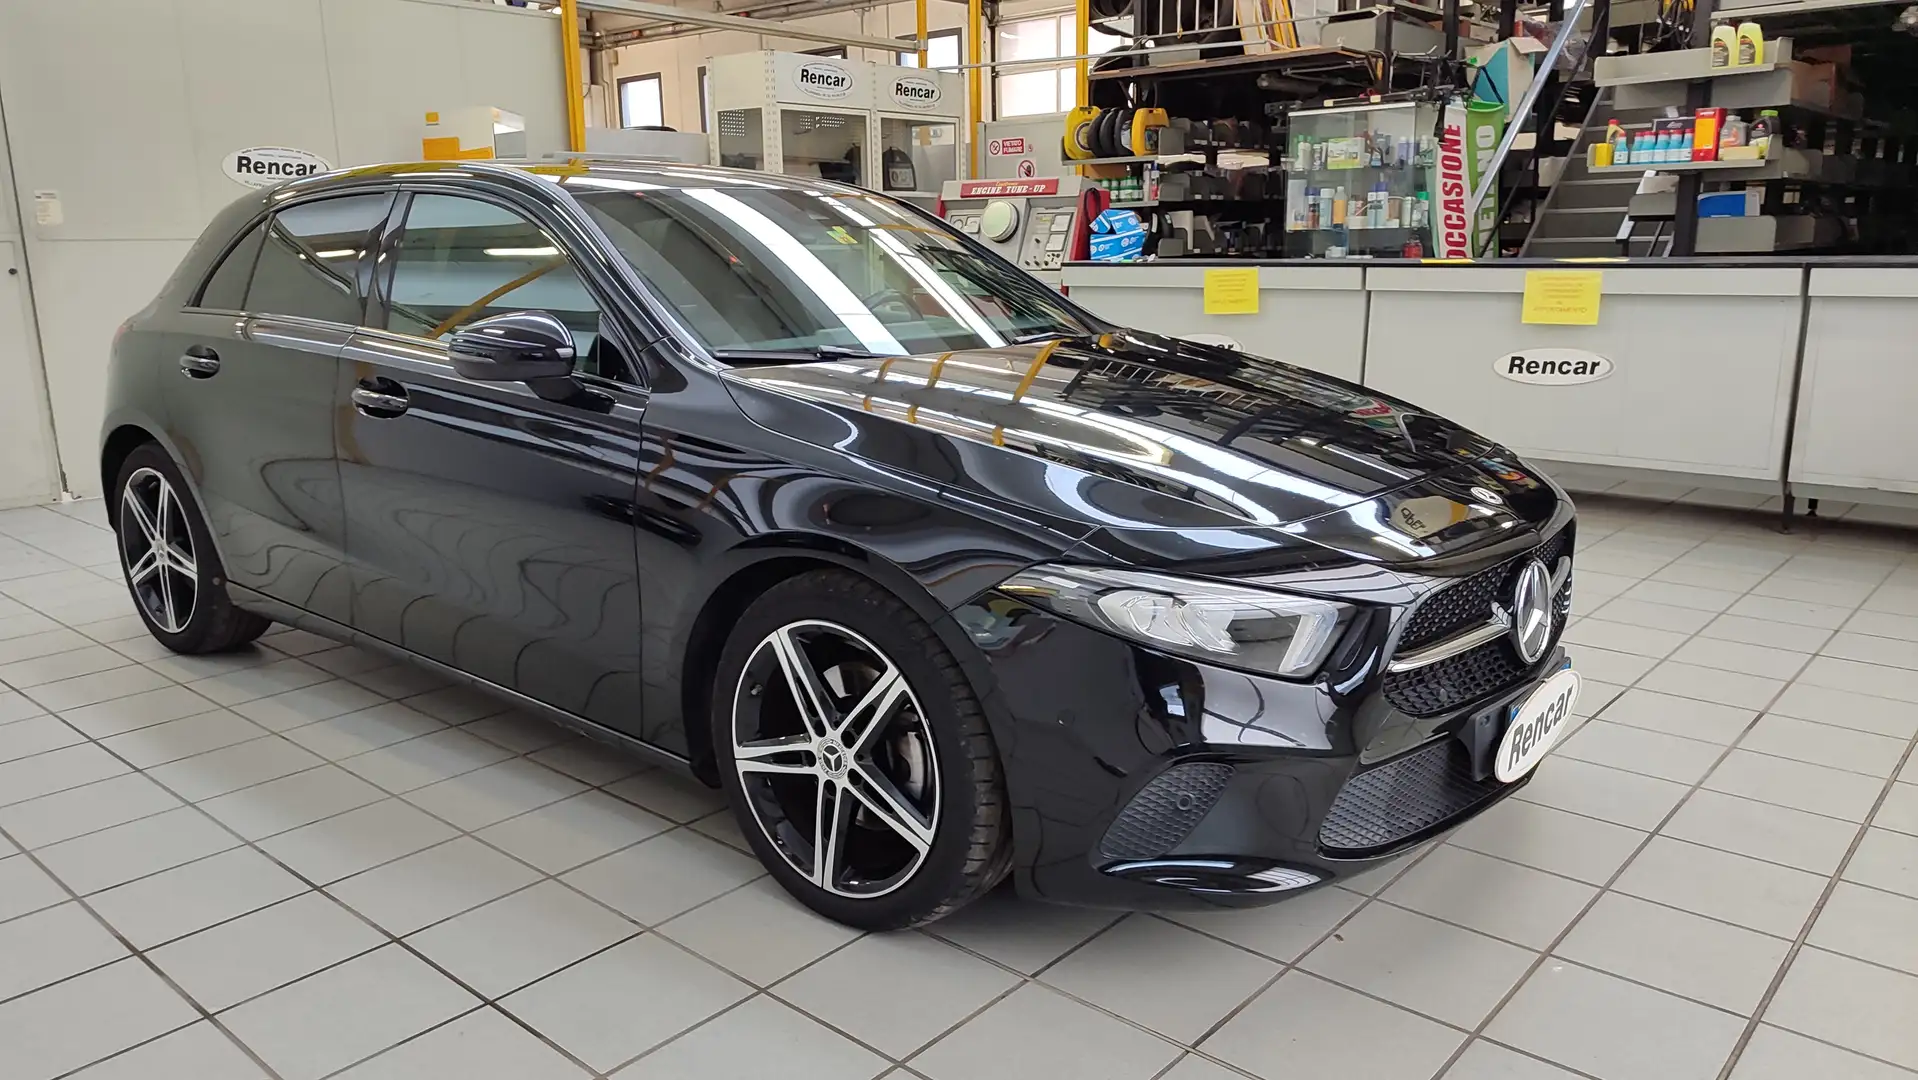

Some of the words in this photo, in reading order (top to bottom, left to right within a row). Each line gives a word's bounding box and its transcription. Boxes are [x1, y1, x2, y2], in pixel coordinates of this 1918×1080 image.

[800, 68, 846, 87] Rencar
[895, 82, 935, 99] Rencar
[236, 155, 317, 176] Rencar
[971, 186, 1003, 195] ENGINE
[1476, 125, 1496, 258] METNO
[1507, 355, 1601, 375] Rencar
[1507, 684, 1574, 772] Rencar
